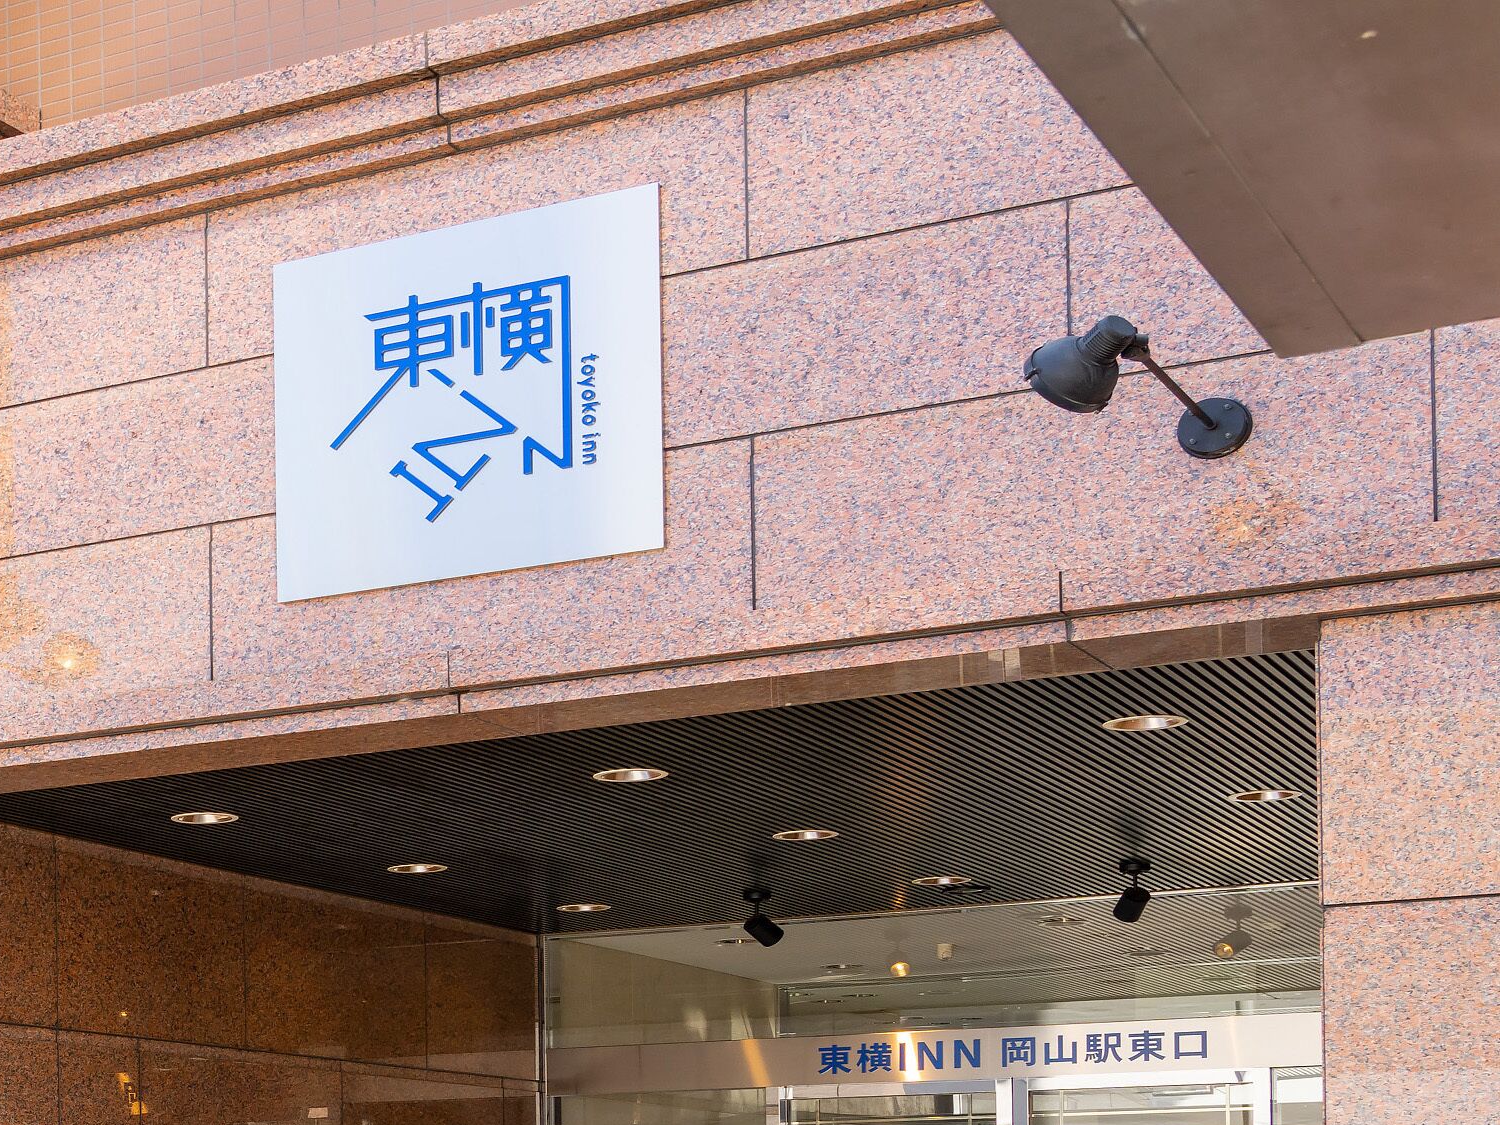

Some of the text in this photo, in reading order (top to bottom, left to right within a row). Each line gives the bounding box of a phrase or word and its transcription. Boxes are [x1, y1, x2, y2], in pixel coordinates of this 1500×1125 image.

[576, 352, 601, 466] toyoko inn
[817, 1030, 1209, 1075] 東横INN 岡山駅東口
